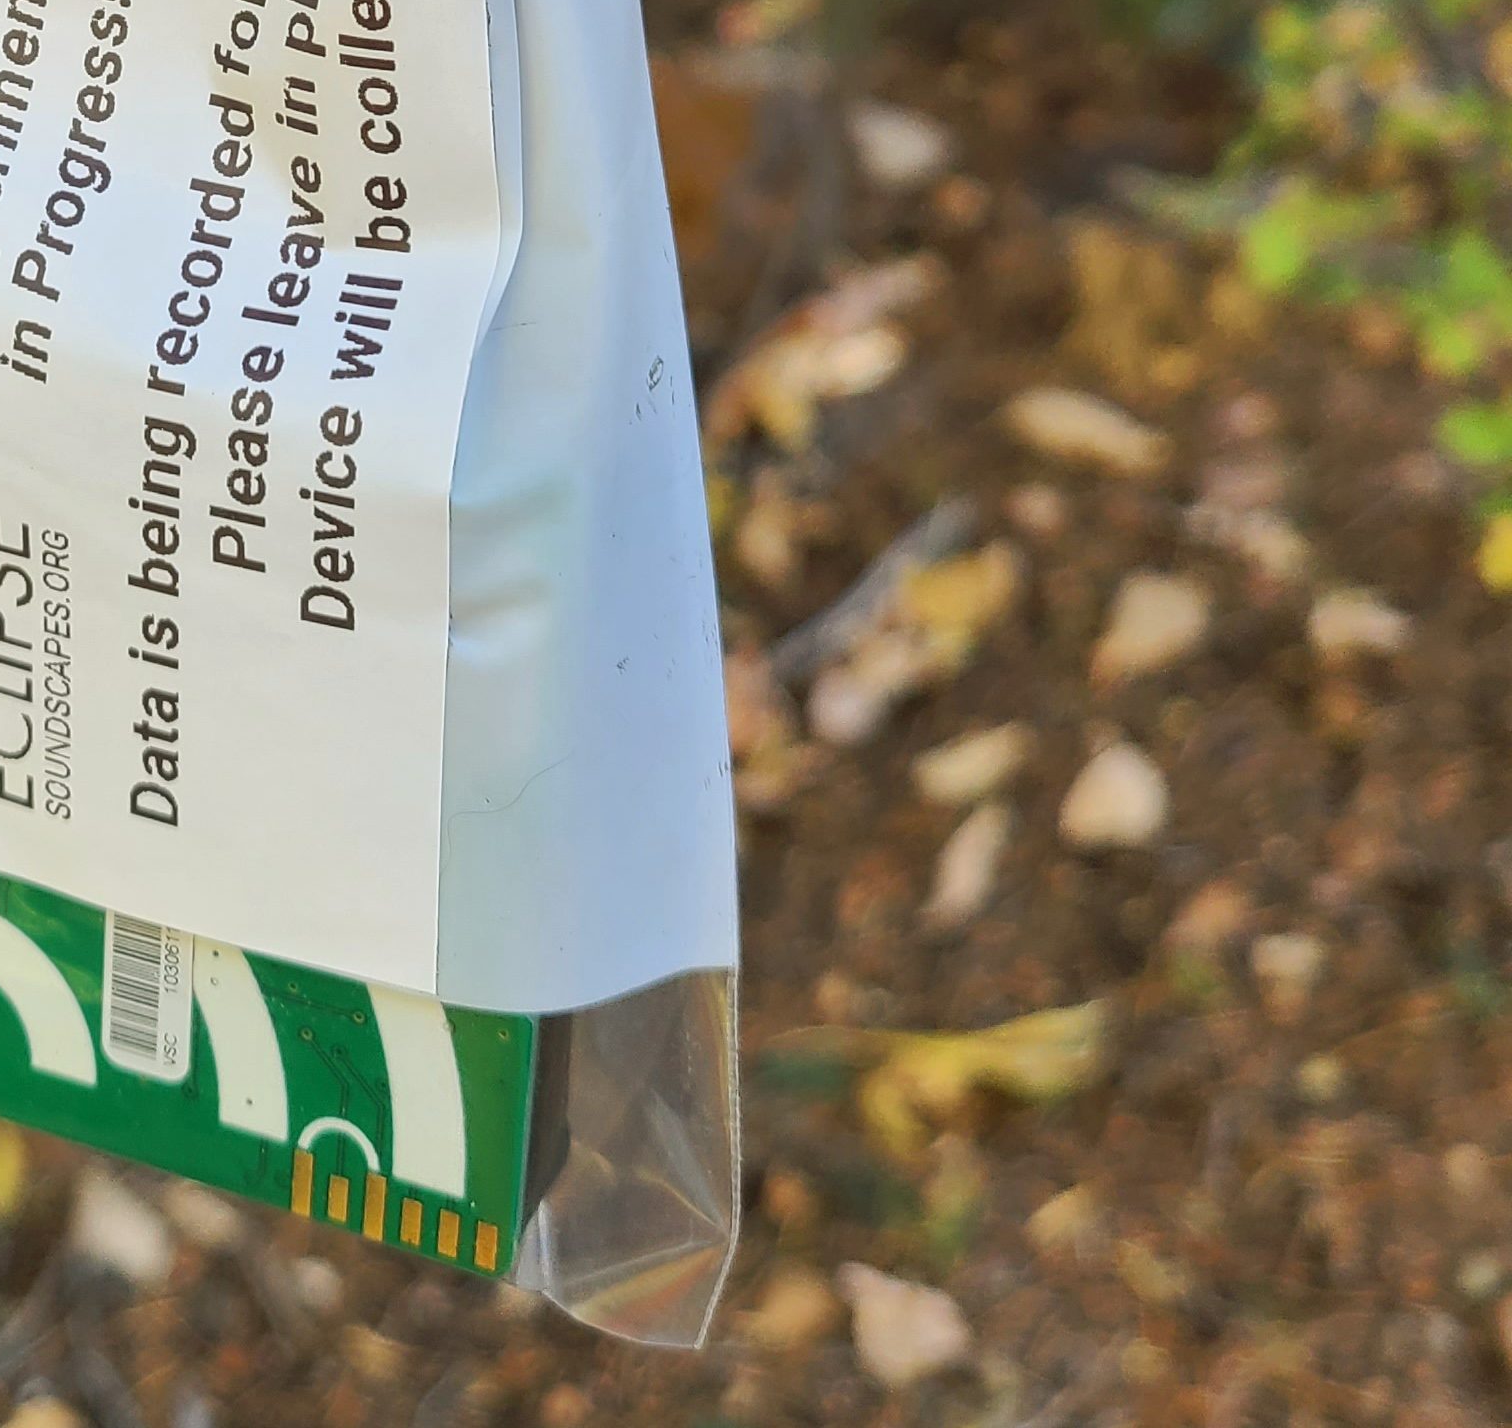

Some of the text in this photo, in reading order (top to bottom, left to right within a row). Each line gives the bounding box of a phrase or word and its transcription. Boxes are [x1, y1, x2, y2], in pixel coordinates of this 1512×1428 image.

[274, 75, 320, 135] in
[146, 92, 256, 395] recorded
[241, 154, 325, 327] leave
[355, 175, 412, 253] be
[328, 271, 405, 380] will
[127, 414, 198, 597] being
[208, 344, 285, 573] Please
[298, 404, 363, 631] Device
[40, 527, 72, 819] SOUNDSCAPES.ORG
[127, 613, 180, 669] is
[129, 685, 180, 826] Data
[162, 1032, 178, 1065] VSC
